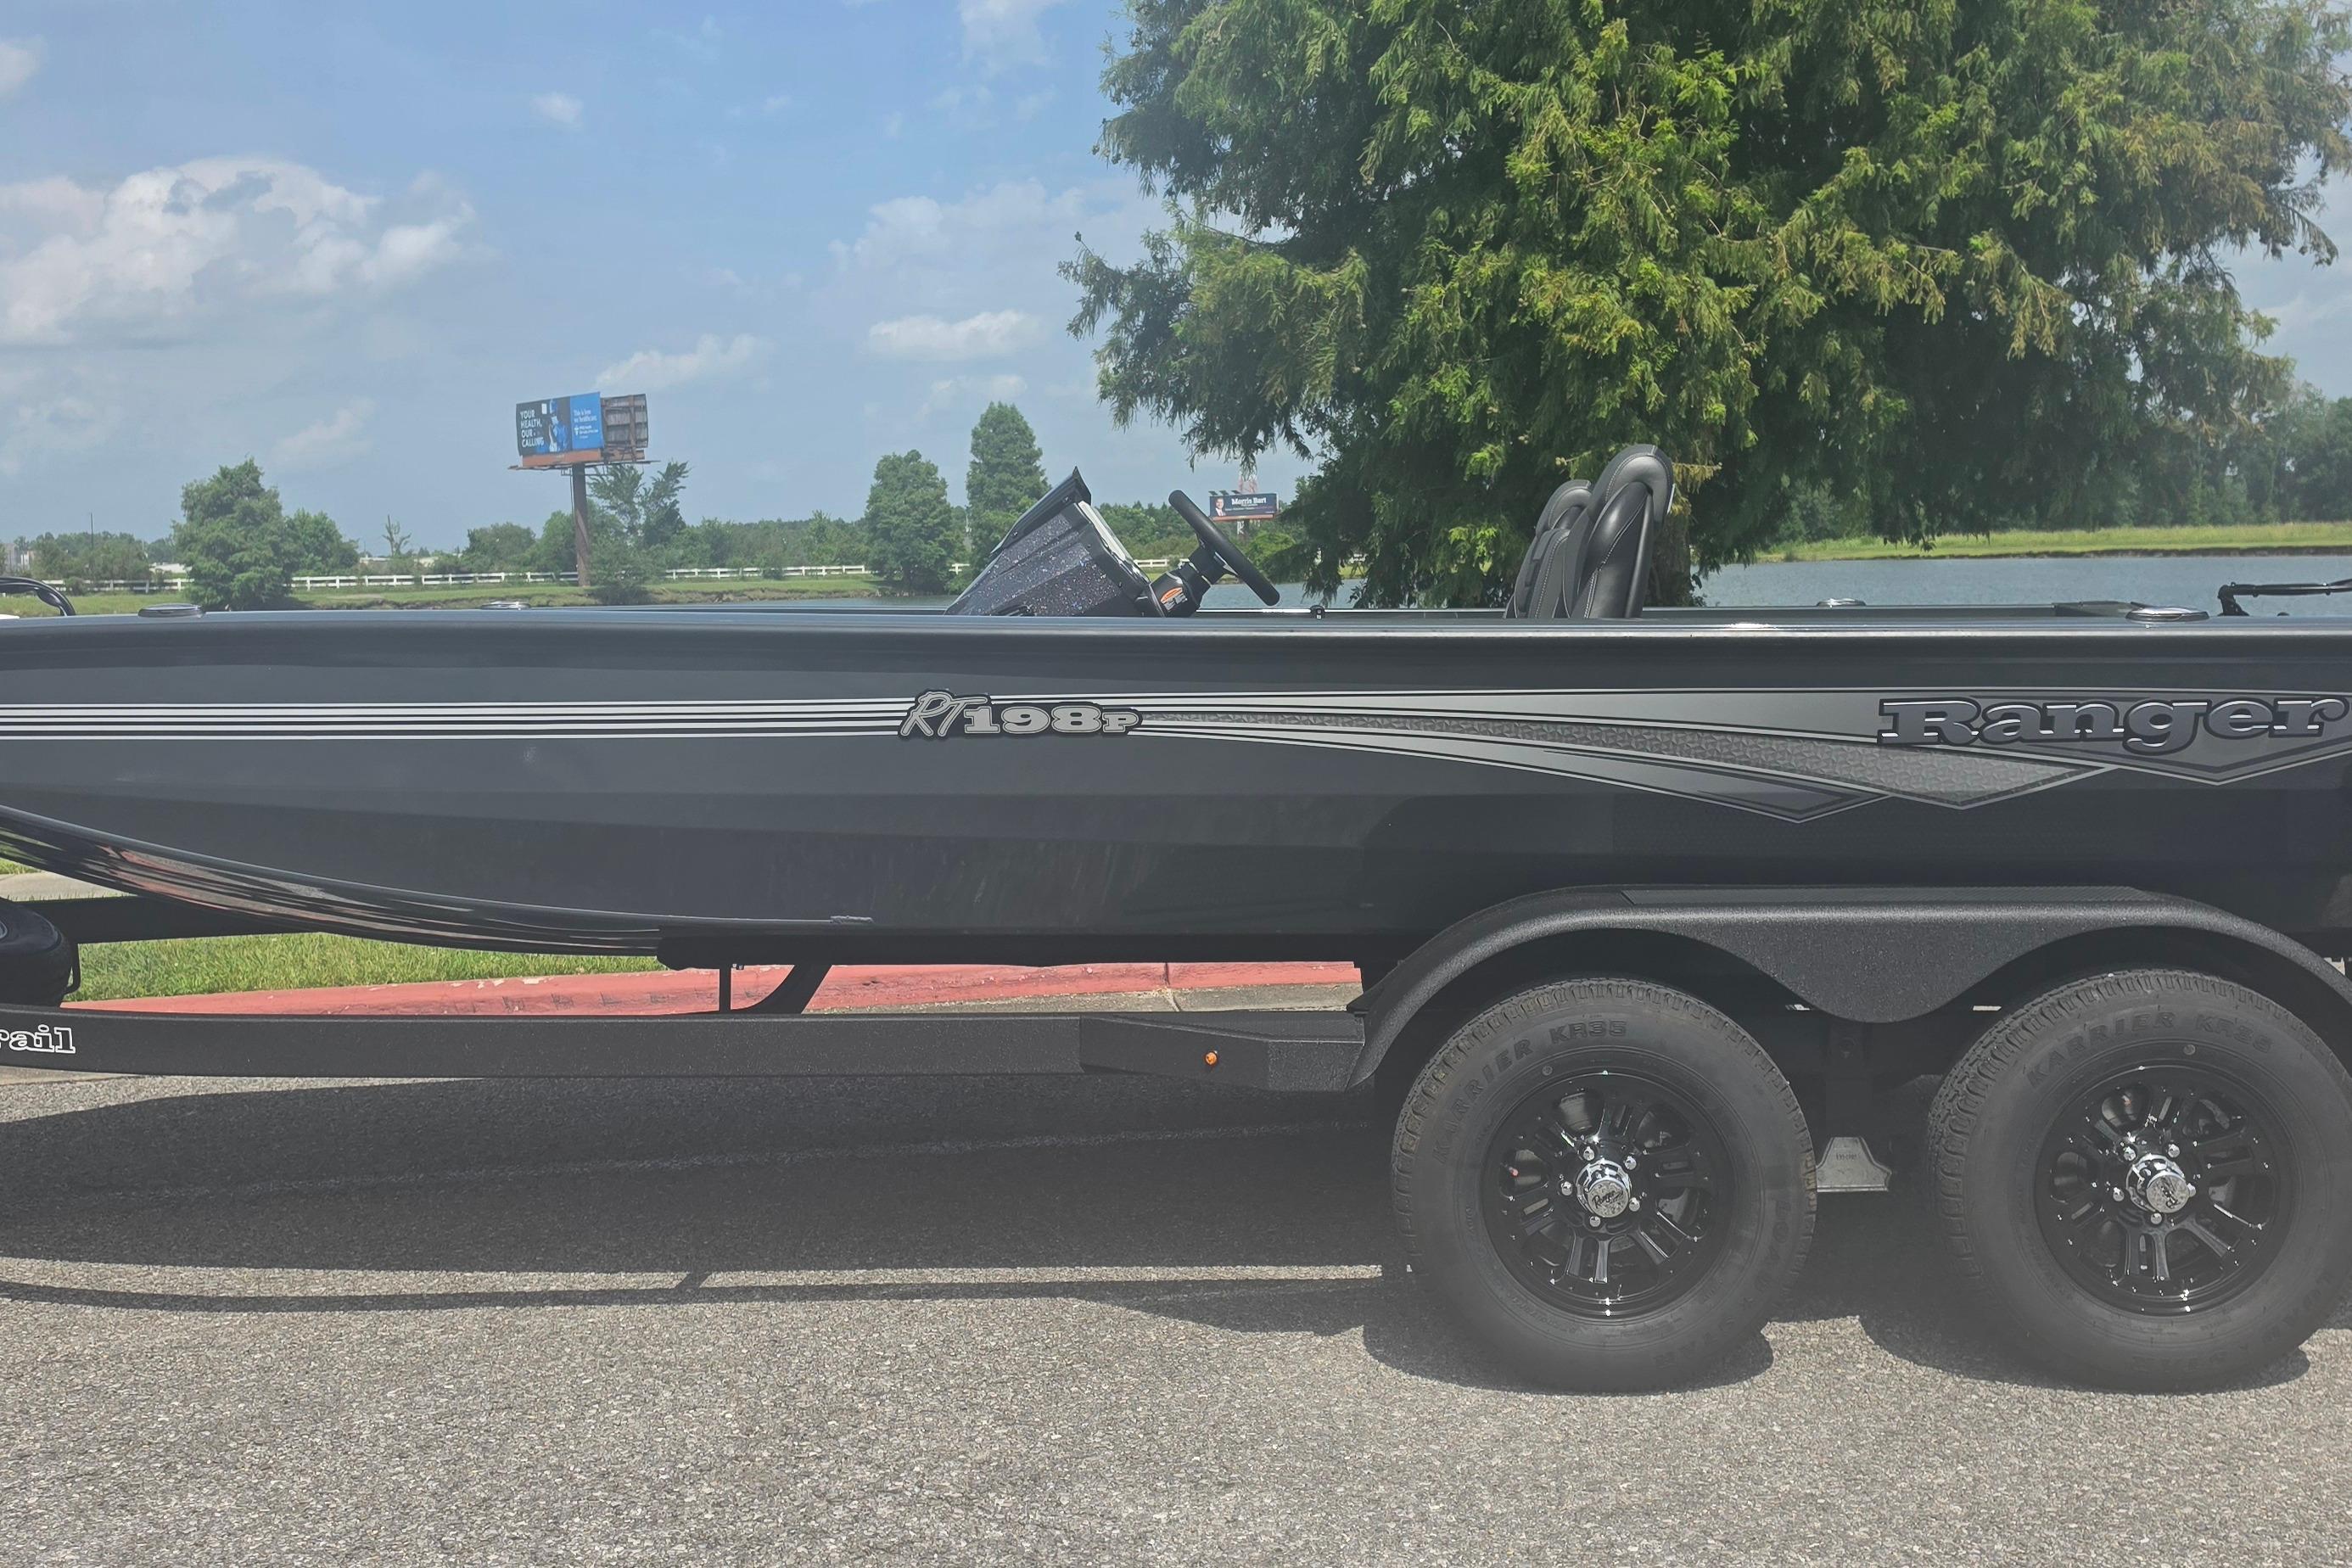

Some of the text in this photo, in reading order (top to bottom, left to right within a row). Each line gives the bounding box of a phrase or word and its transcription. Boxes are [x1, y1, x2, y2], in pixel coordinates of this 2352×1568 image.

[520, 409, 535, 419] YOUR
[521, 428, 533, 438] OUR
[522, 437, 544, 447] CALLING
[1878, 697, 2351, 755] Ranger
[1548, 1020, 1627, 1044] KR35
